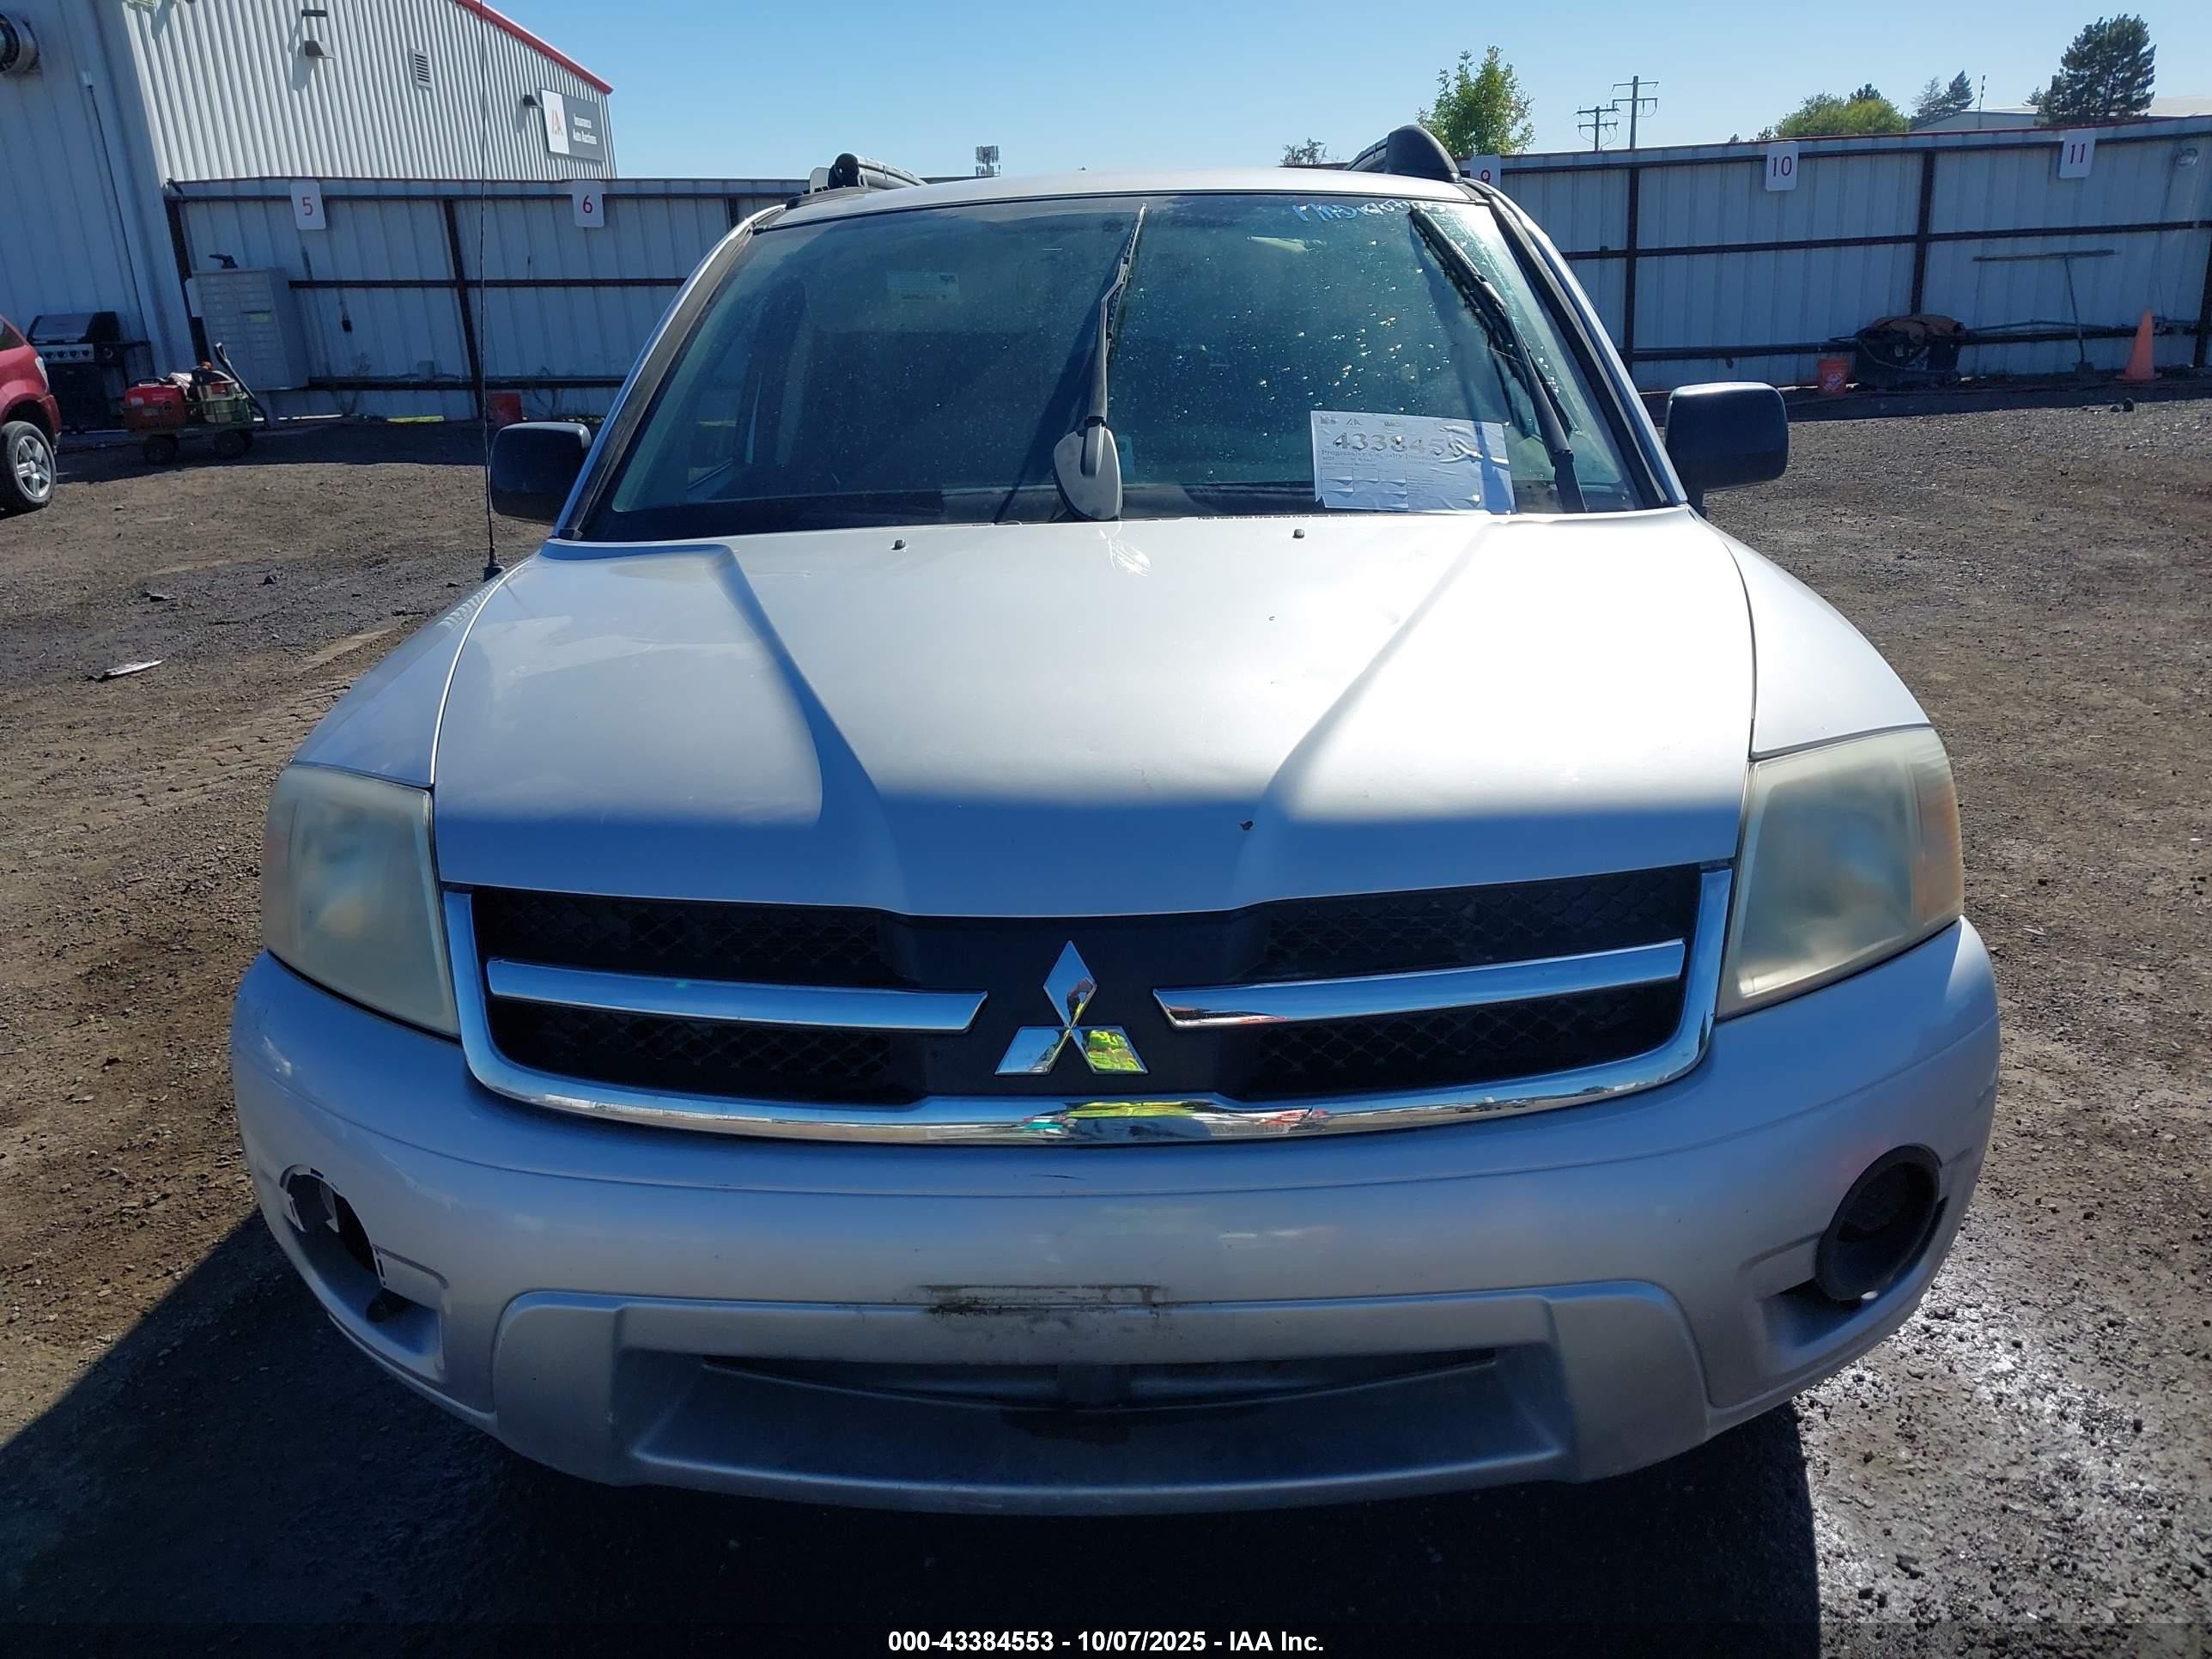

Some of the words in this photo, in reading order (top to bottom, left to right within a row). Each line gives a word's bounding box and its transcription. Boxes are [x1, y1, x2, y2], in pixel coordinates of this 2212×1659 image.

[2069, 143, 2087, 164] 11
[1772, 155, 1792, 177] 10
[1480, 169, 1491, 184] 9
[301, 196, 313, 216] 5
[582, 194, 592, 214] 6
